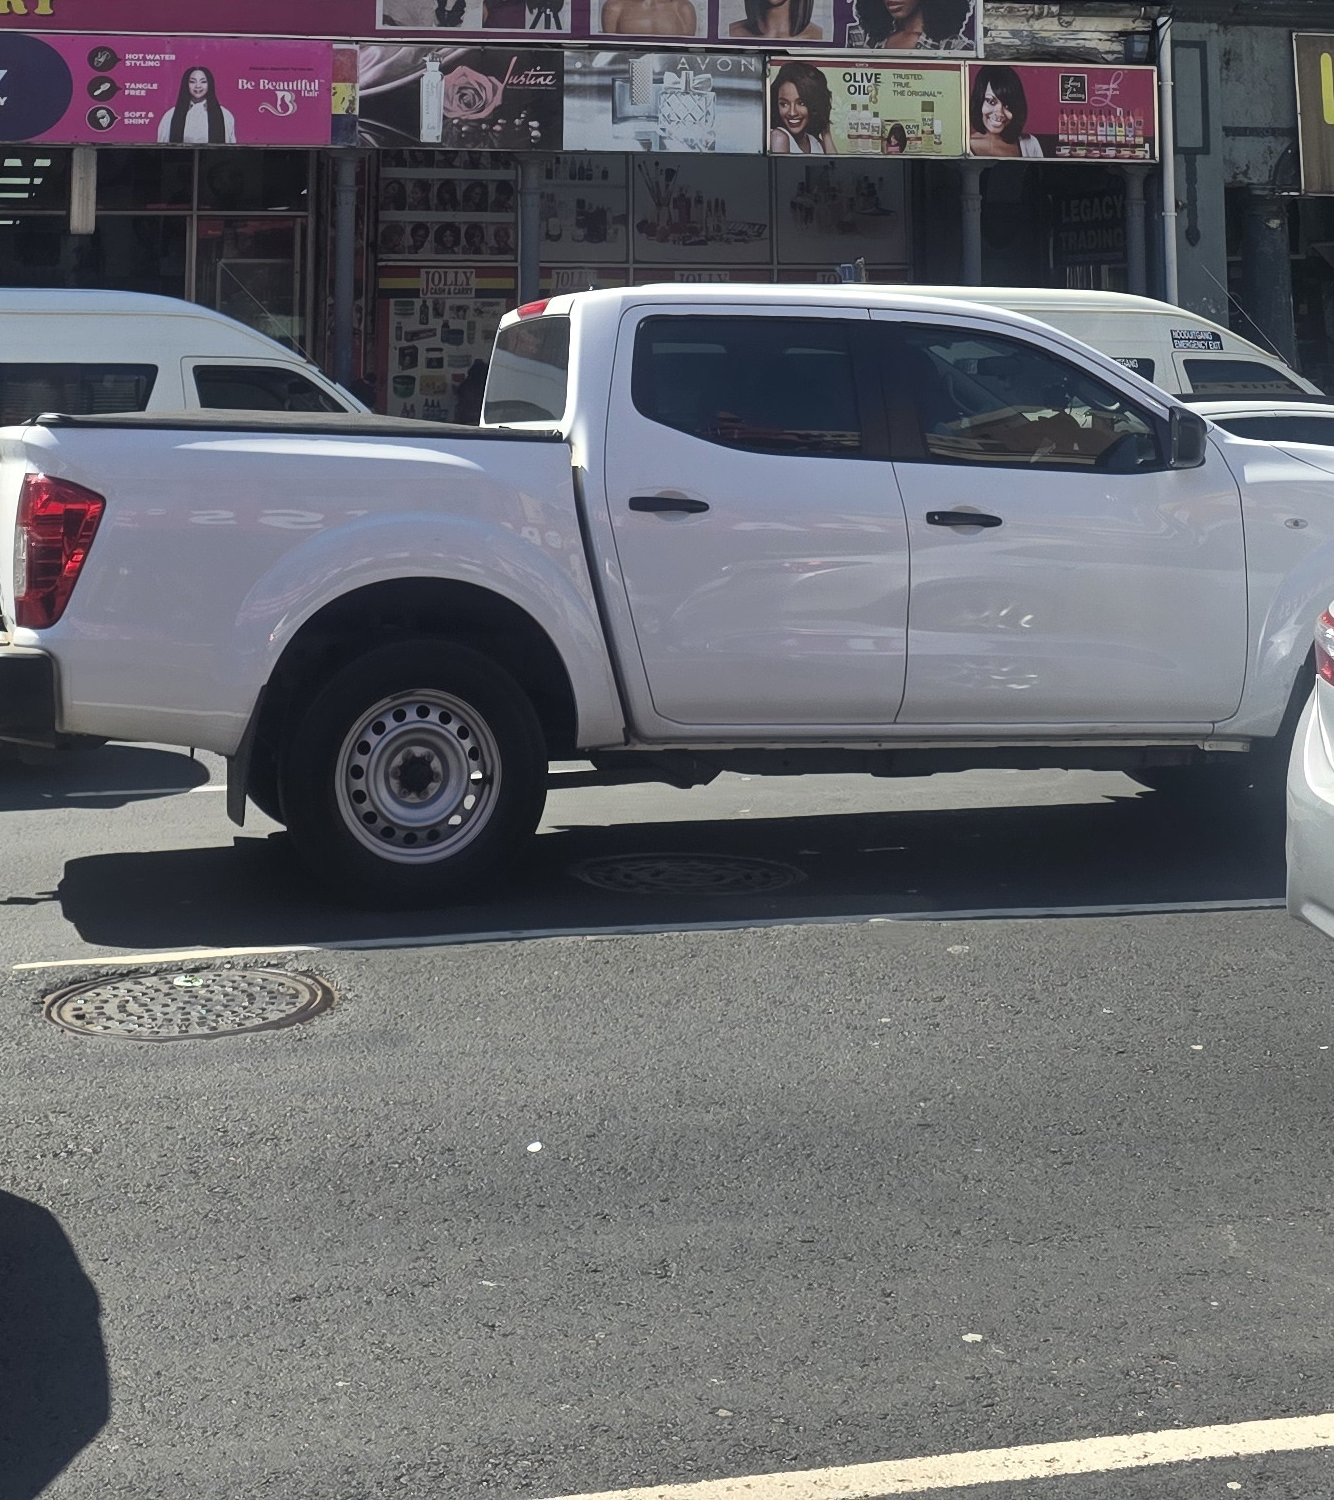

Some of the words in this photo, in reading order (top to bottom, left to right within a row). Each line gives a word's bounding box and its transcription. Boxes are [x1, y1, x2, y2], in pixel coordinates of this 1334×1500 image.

[125, 53, 144, 61] HOT
[502, 56, 556, 86] Justine
[676, 57, 756, 73] AVON
[238, 79, 255, 90] Be
[260, 79, 320, 91] Beautiful
[842, 72, 882, 84] OLIVE
[847, 84, 870, 96] OIL
[1061, 195, 1123, 223] LEGACY
[1060, 227, 1125, 250] TRADING
[422, 270, 474, 296] JOLLY
[1174, 340, 1209, 349] EMERGENCY
[1209, 341, 1221, 350] EXIT
